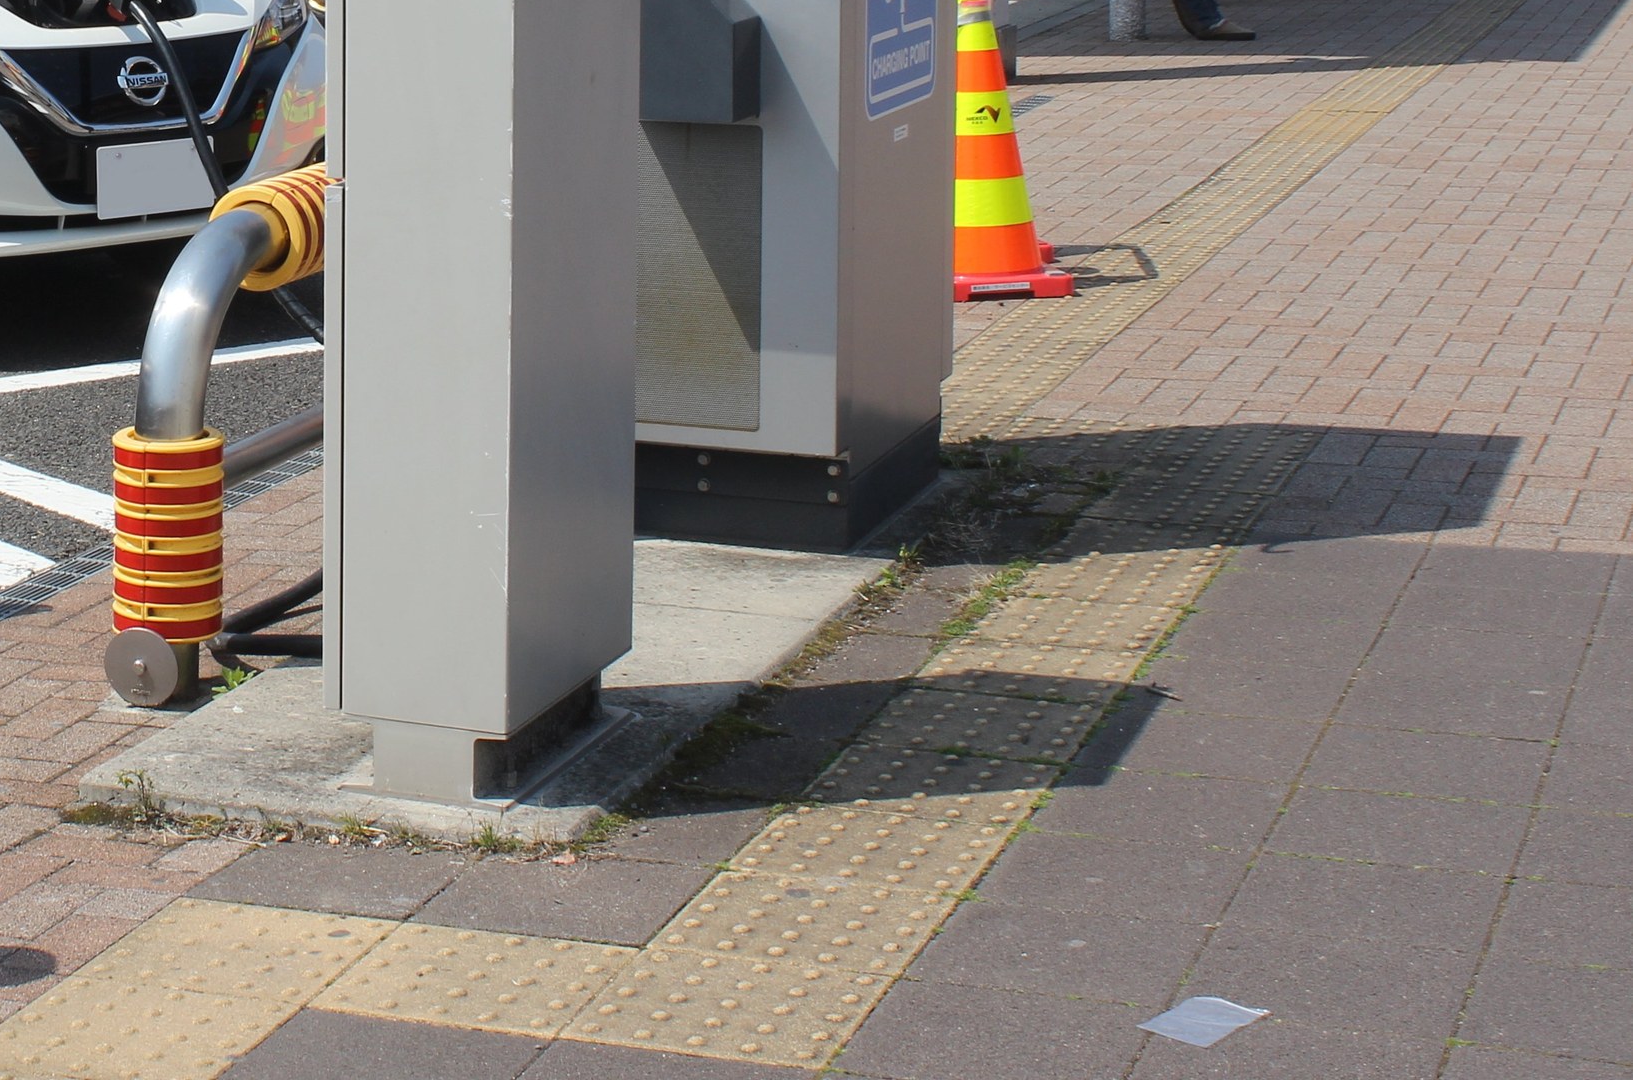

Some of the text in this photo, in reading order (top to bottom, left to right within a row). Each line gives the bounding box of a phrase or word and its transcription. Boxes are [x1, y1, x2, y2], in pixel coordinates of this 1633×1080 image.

[872, 40, 931, 80] CHARGING POINT
[126, 75, 167, 86] NISSAN
